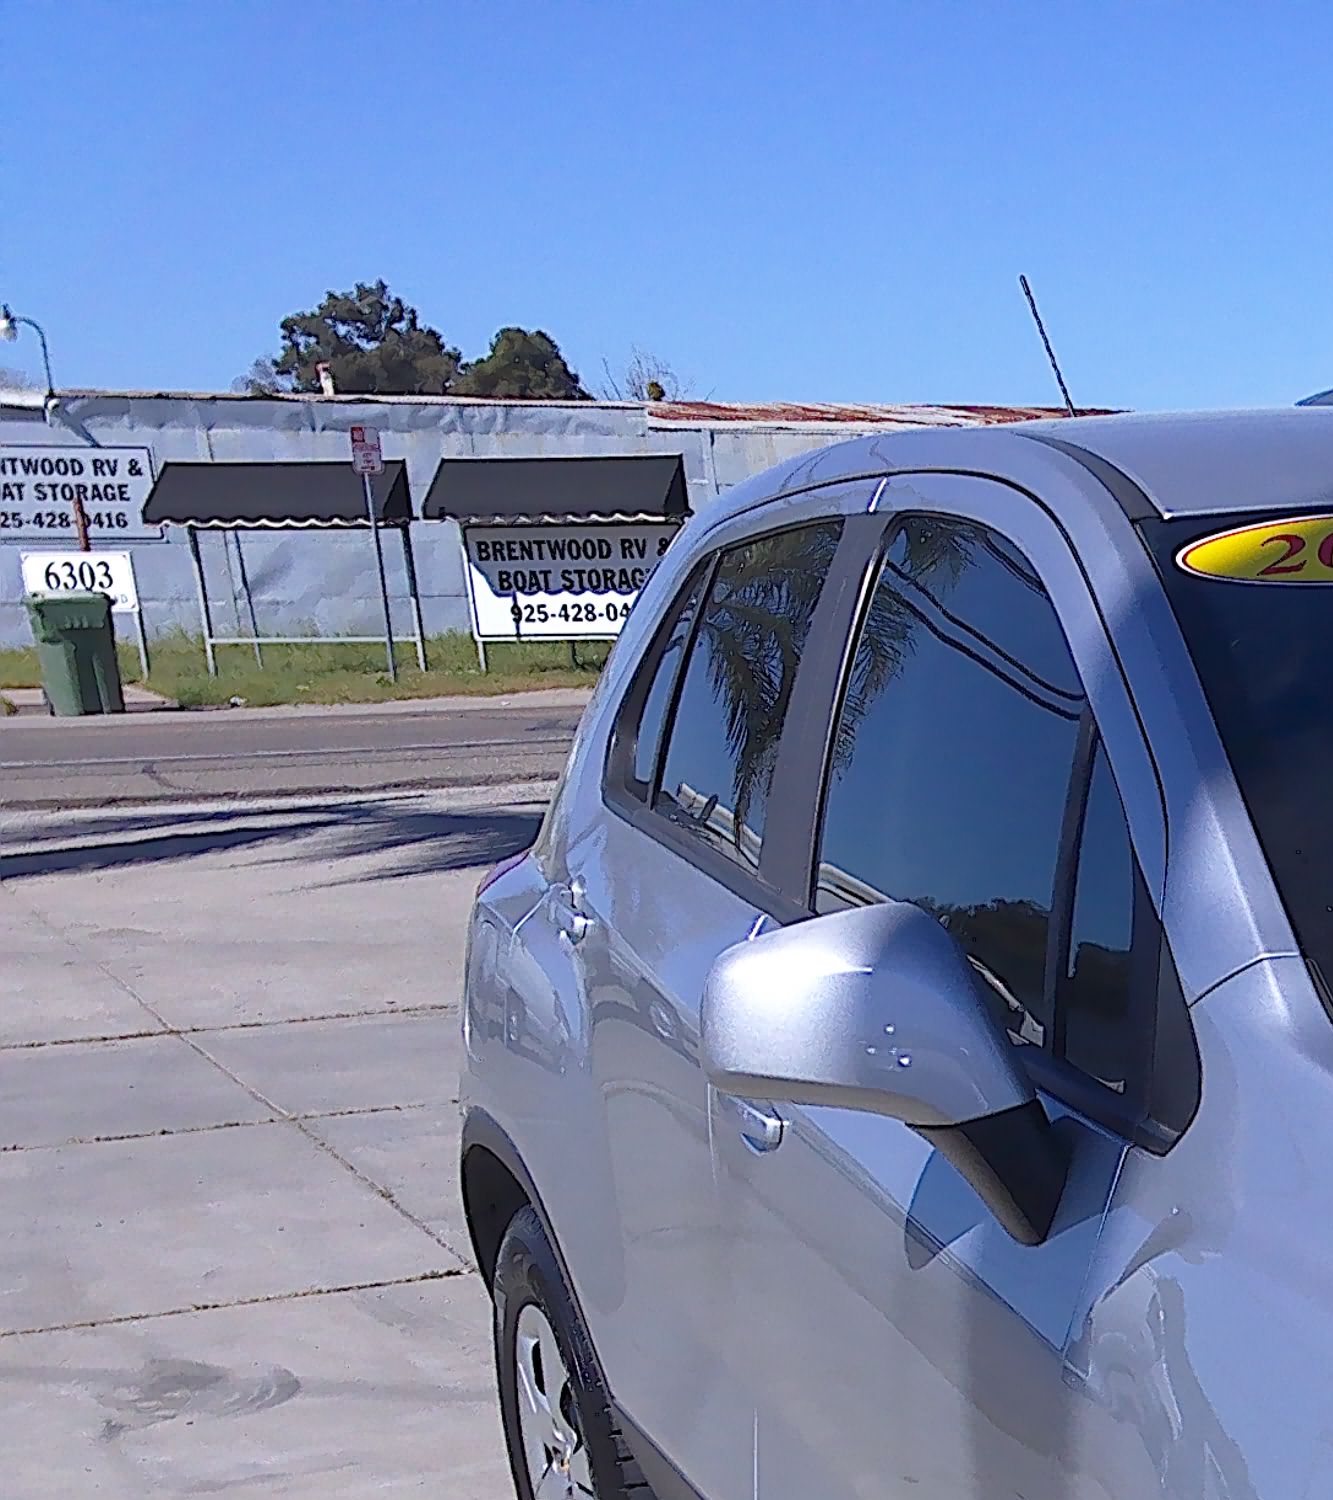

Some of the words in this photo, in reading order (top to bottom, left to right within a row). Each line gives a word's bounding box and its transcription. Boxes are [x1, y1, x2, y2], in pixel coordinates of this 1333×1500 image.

[92, 458, 118, 477] RV
[127, 457, 144, 477] &
[34, 482, 131, 502] STORAGE
[475, 537, 613, 563] BRENTWOOD
[619, 537, 647, 560] RV
[44, 560, 114, 591] 6303
[498, 568, 552, 592] BOAT
